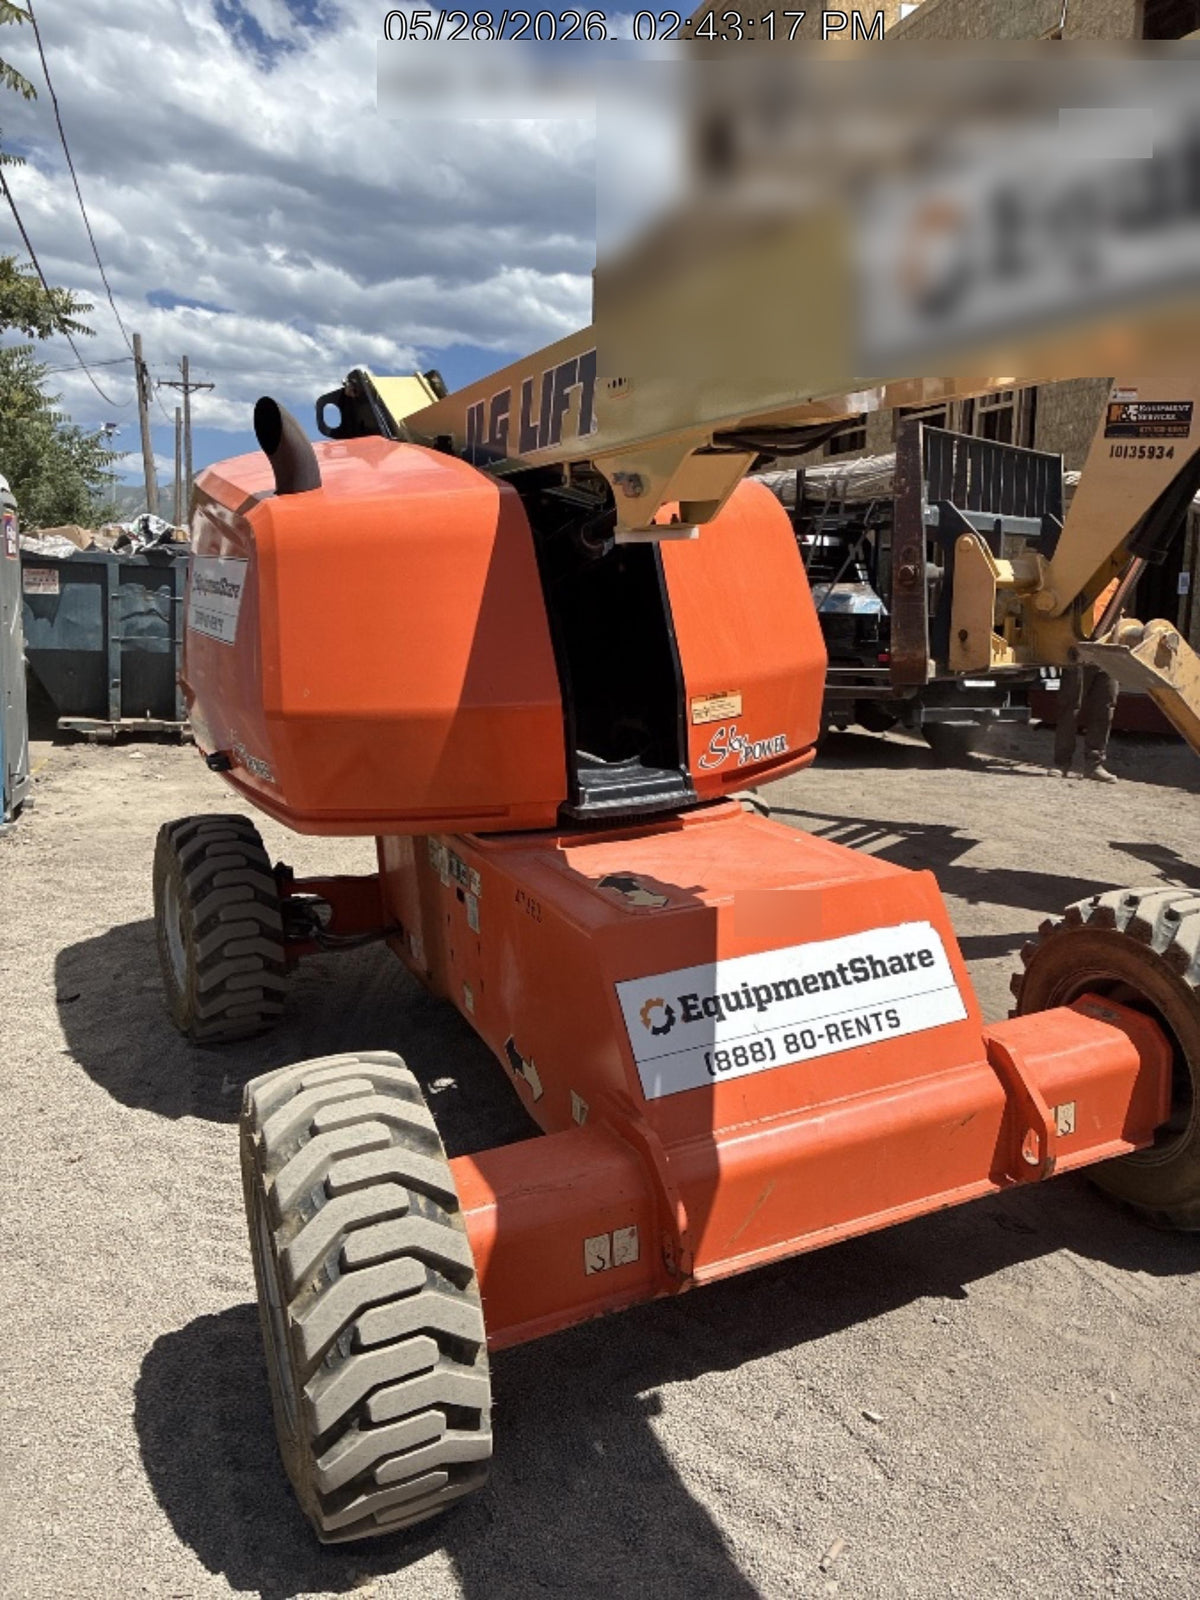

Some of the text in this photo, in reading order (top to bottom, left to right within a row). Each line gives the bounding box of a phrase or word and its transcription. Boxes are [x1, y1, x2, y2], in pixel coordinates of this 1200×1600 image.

[518, 346, 598, 455] LIFT
[1109, 444, 1175, 460] 10135934
[676, 948, 936, 1023] EquipmentShare
[704, 1008, 902, 1076] (888) 80-RENTS
